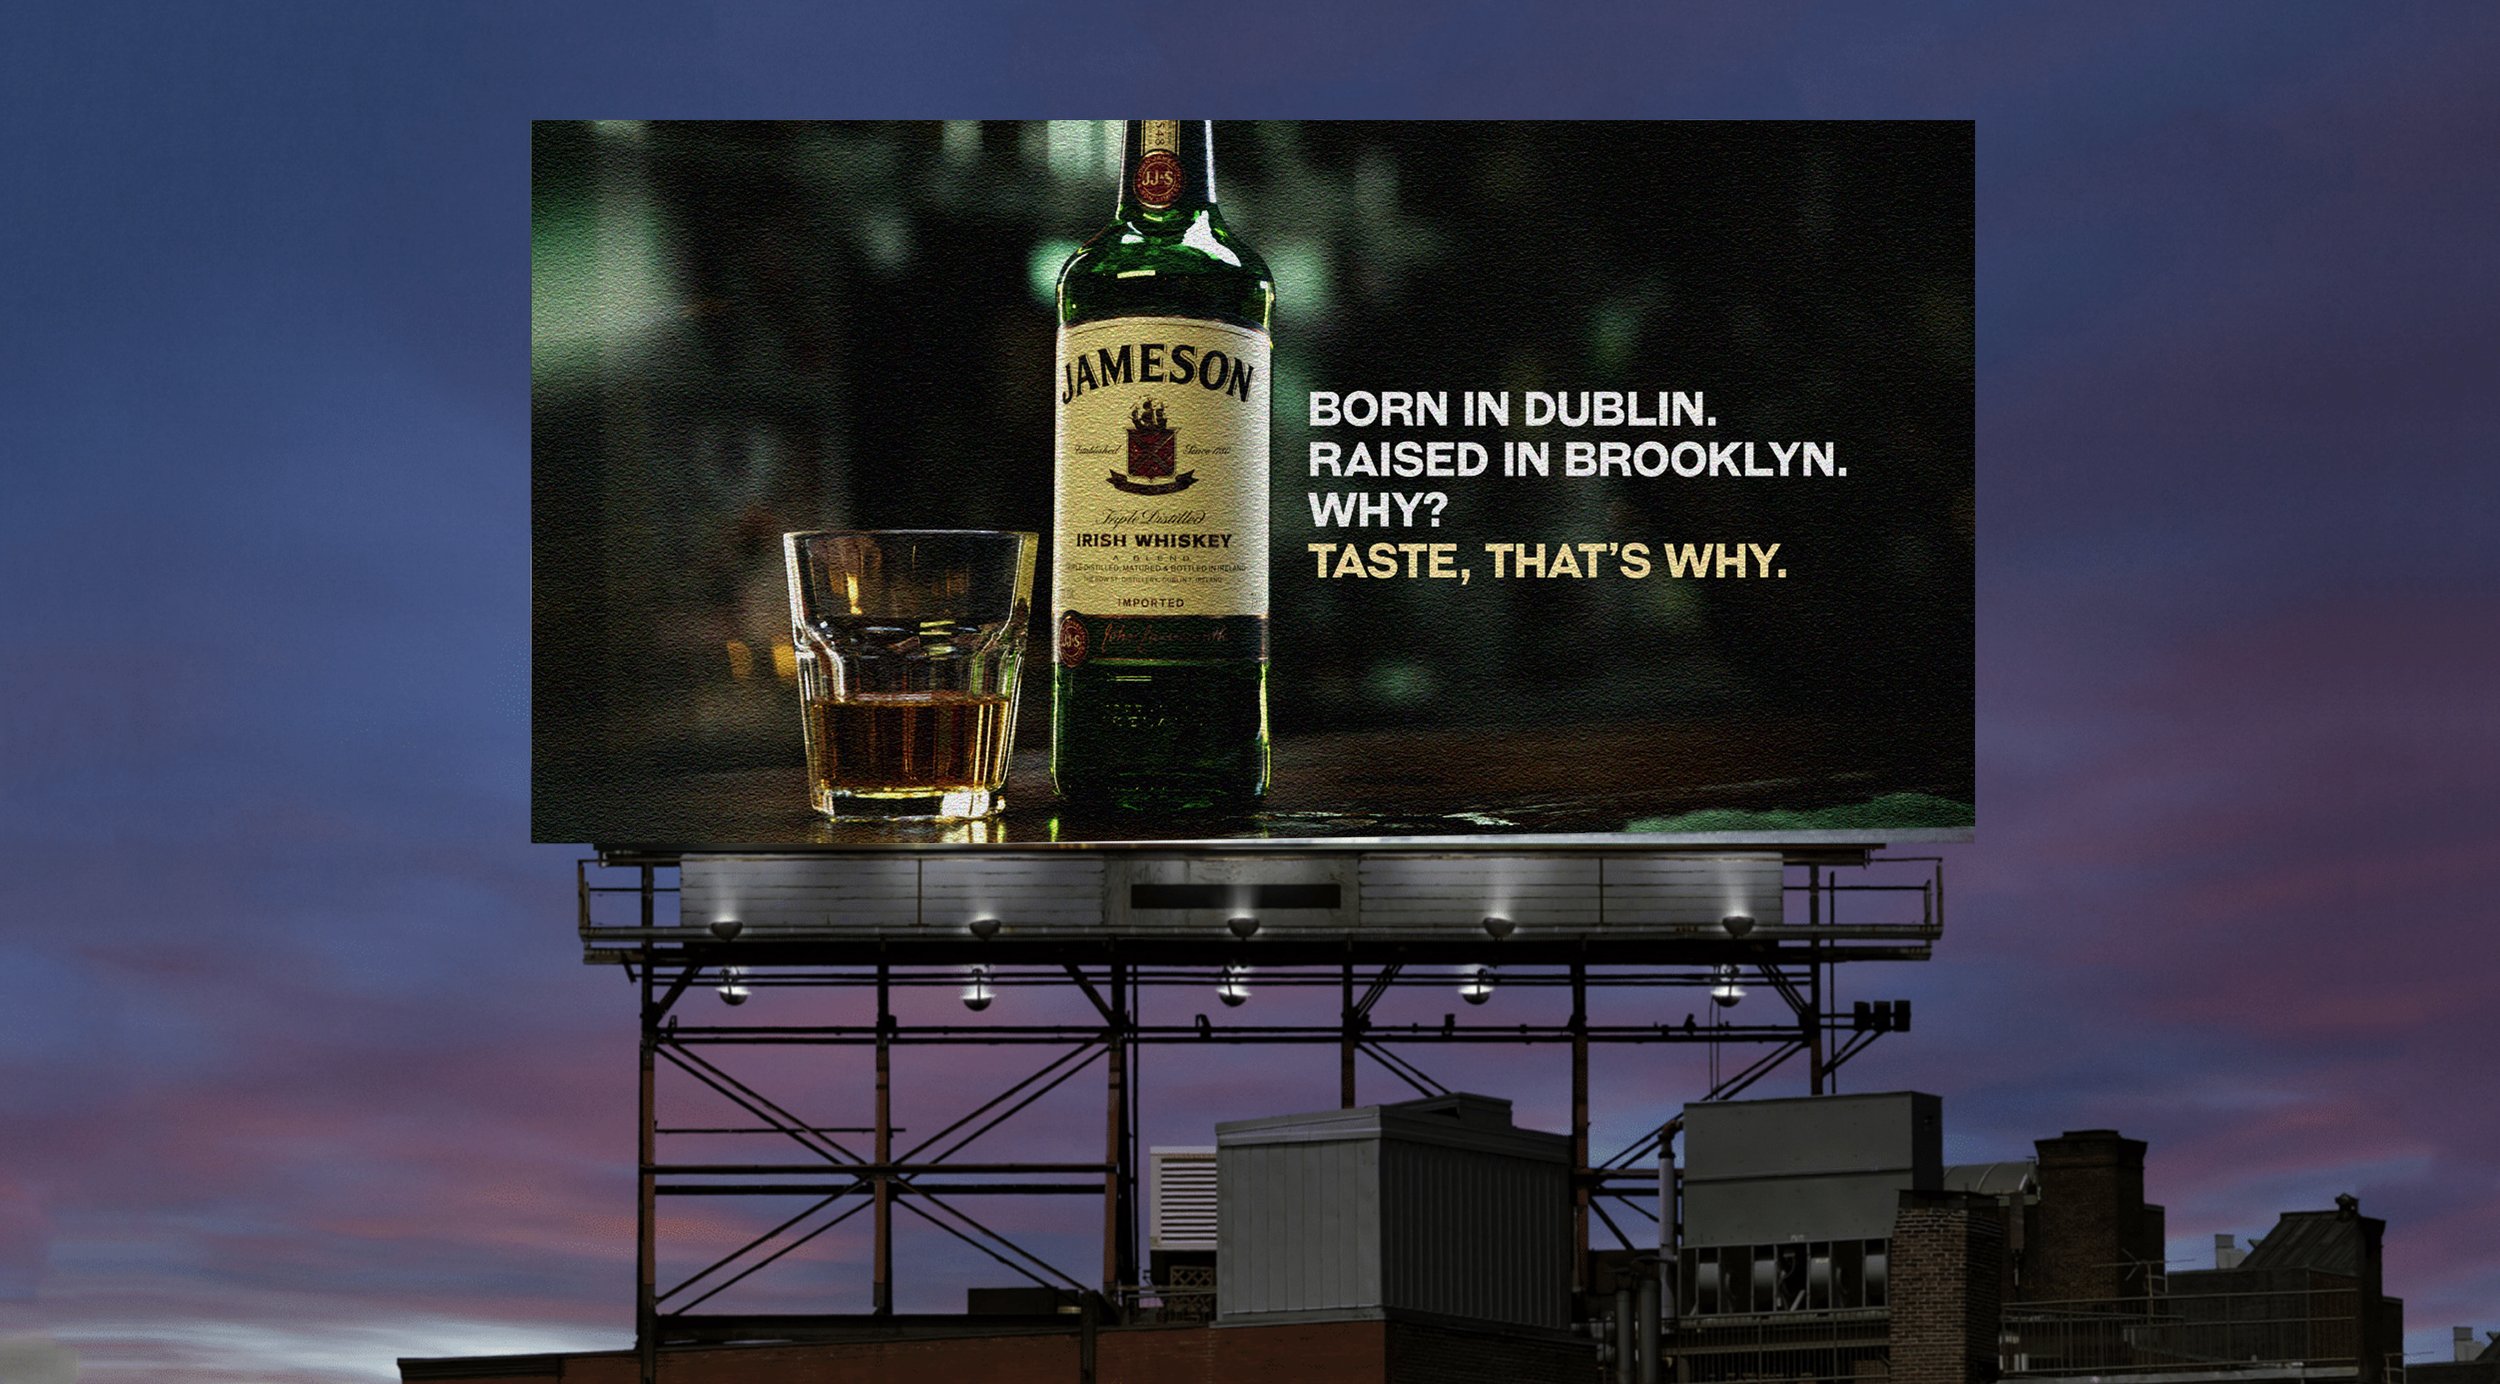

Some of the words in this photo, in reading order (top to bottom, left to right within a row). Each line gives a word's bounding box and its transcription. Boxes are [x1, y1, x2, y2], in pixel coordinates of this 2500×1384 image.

[1062, 343, 1255, 405] JAMESON
[1309, 391, 1448, 427] BORN
[1464, 391, 1509, 427] IN
[1525, 391, 1717, 427] DUBLIN.
[1074, 444, 1122, 455] Established
[1183, 444, 1211, 455] Since
[1309, 441, 1489, 478] RAISED
[1504, 441, 1549, 477] IN
[1565, 441, 1847, 478] BROOKLYN.
[1098, 508, 1140, 530] Triple
[1140, 508, 1206, 525] Distilled
[1308, 491, 1448, 528] WHY?
[1076, 533, 1127, 548] IRISH
[1134, 533, 1232, 549] WHISKEY
[1133, 554, 1191, 562] BLEND
[1308, 542, 1470, 585] TASTE,
[1485, 542, 1651, 579] THAT’S
[1665, 542, 1787, 578] WHY.
[1123, 564, 1162, 572] MATURED
[1170, 564, 1208, 573] BOTTLED
[1118, 598, 1185, 608] IMPORTED
